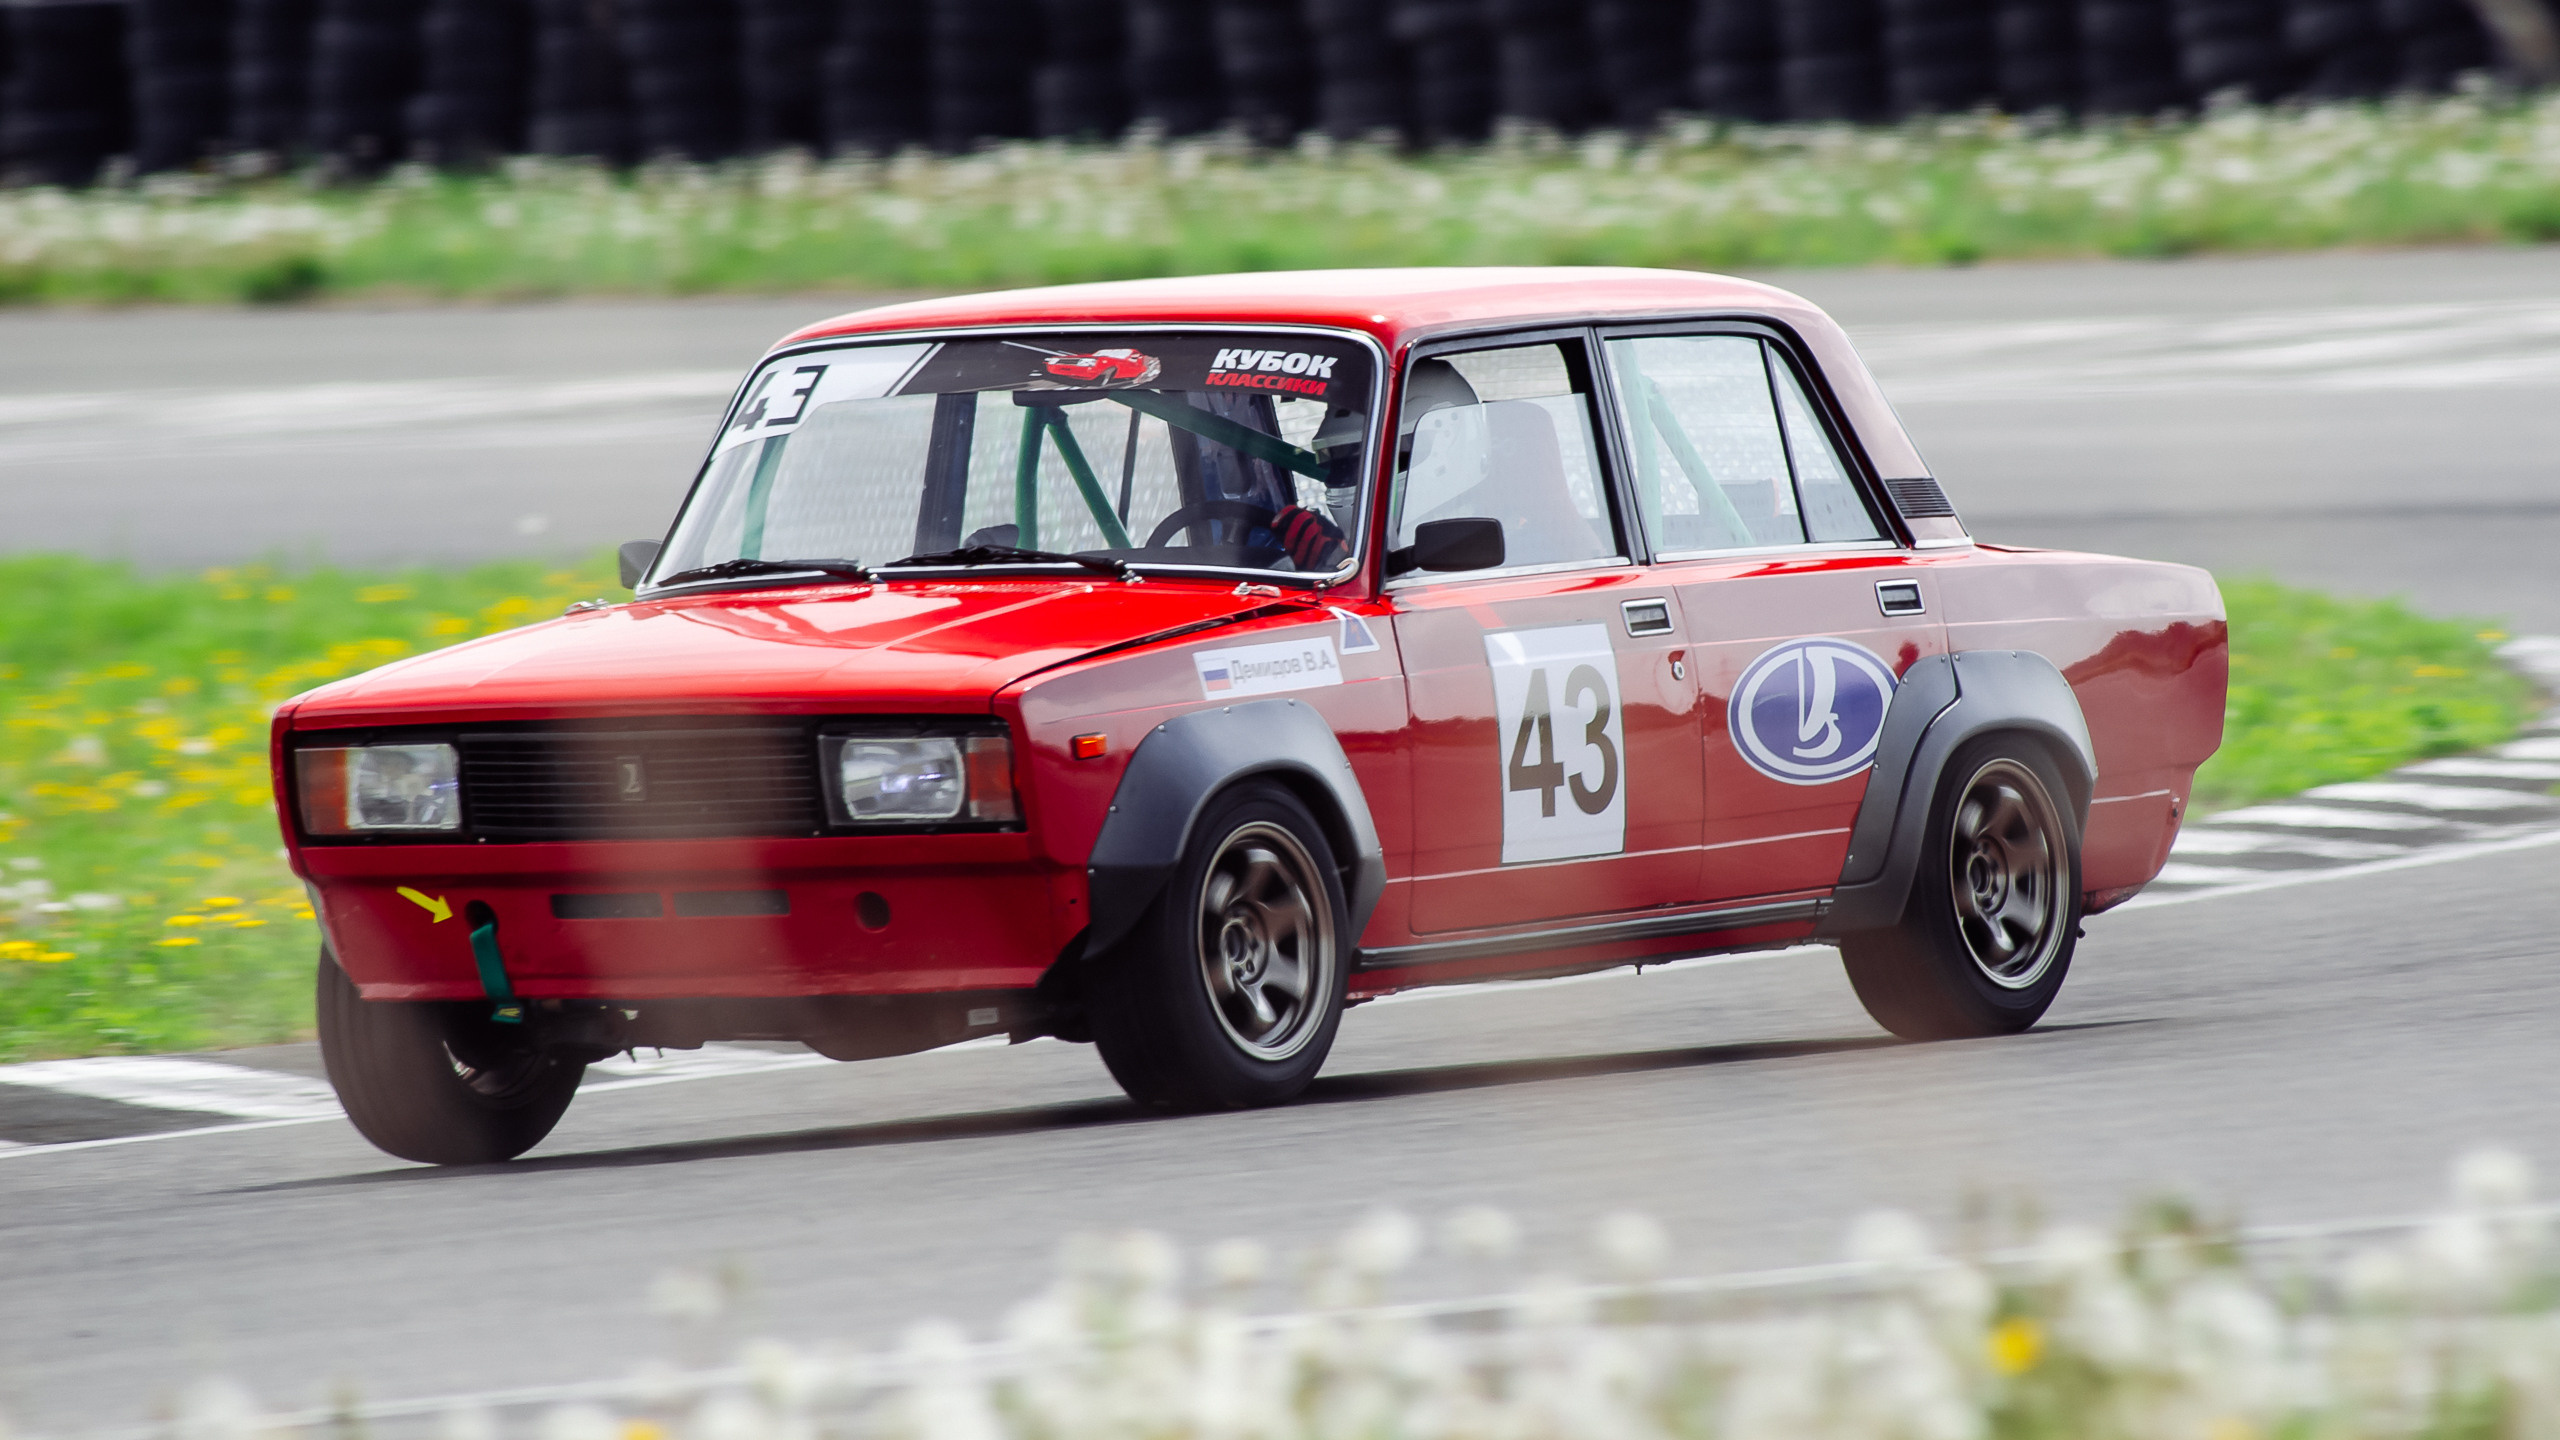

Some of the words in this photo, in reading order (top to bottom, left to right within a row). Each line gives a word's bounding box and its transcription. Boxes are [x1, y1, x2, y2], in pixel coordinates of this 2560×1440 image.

[1211, 348, 1338, 378] КУБОК
[731, 364, 830, 432] 43
[1205, 372, 1327, 396] КЛАССИКИ
[1231, 657, 1302, 684] Демидов
[1303, 649, 1337, 671] В.А.
[1509, 664, 1618, 818] 43
